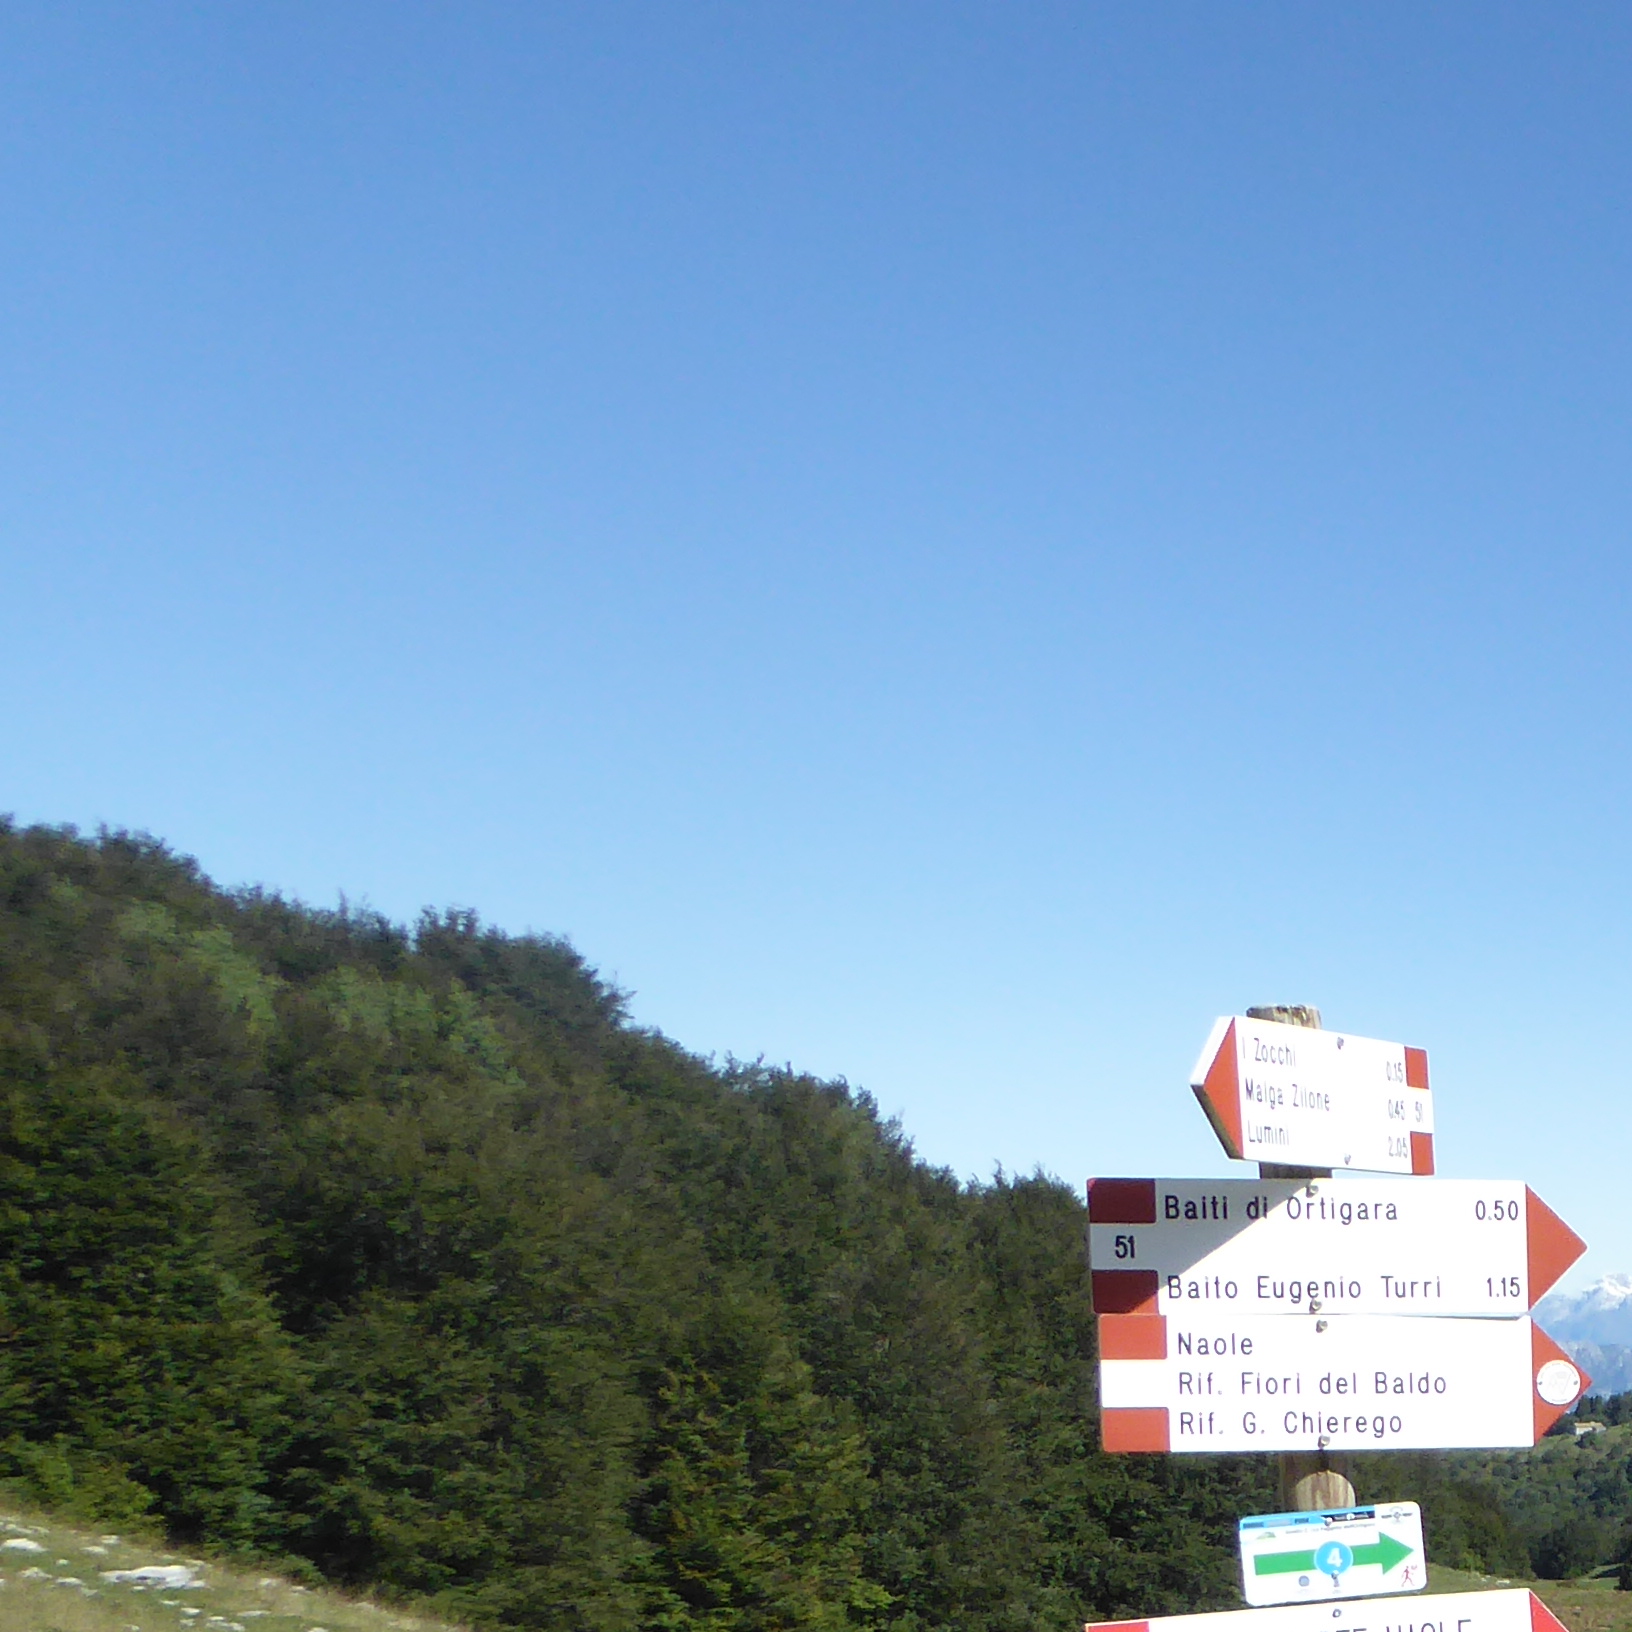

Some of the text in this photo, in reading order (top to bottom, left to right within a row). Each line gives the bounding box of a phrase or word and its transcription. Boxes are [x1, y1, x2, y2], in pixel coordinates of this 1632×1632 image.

[1253, 1037, 1297, 1067] Zocchi
[1386, 1060, 1404, 1084] 0.15
[1245, 1077, 1331, 1112] Malga Zilone
[1387, 1098, 1406, 1121] 0.45
[1414, 1100, 1425, 1123] 51
[1247, 1119, 1290, 1146] Lumini
[1387, 1135, 1409, 1159] 2.05
[1164, 1194, 1398, 1226] Baiti di Ortigara
[1475, 1200, 1519, 1221] 0.50
[1114, 1235, 1136, 1259] 51
[1167, 1275, 1441, 1304] Baito Eugenio Turri
[1486, 1276, 1521, 1298] 1.15
[1177, 1332, 1254, 1356] Naole
[1179, 1371, 1447, 1396] Rif. Fiori del Baldo
[1180, 1410, 1402, 1439] Rif. G. Chierego
[1326, 1547, 1343, 1568] 4
